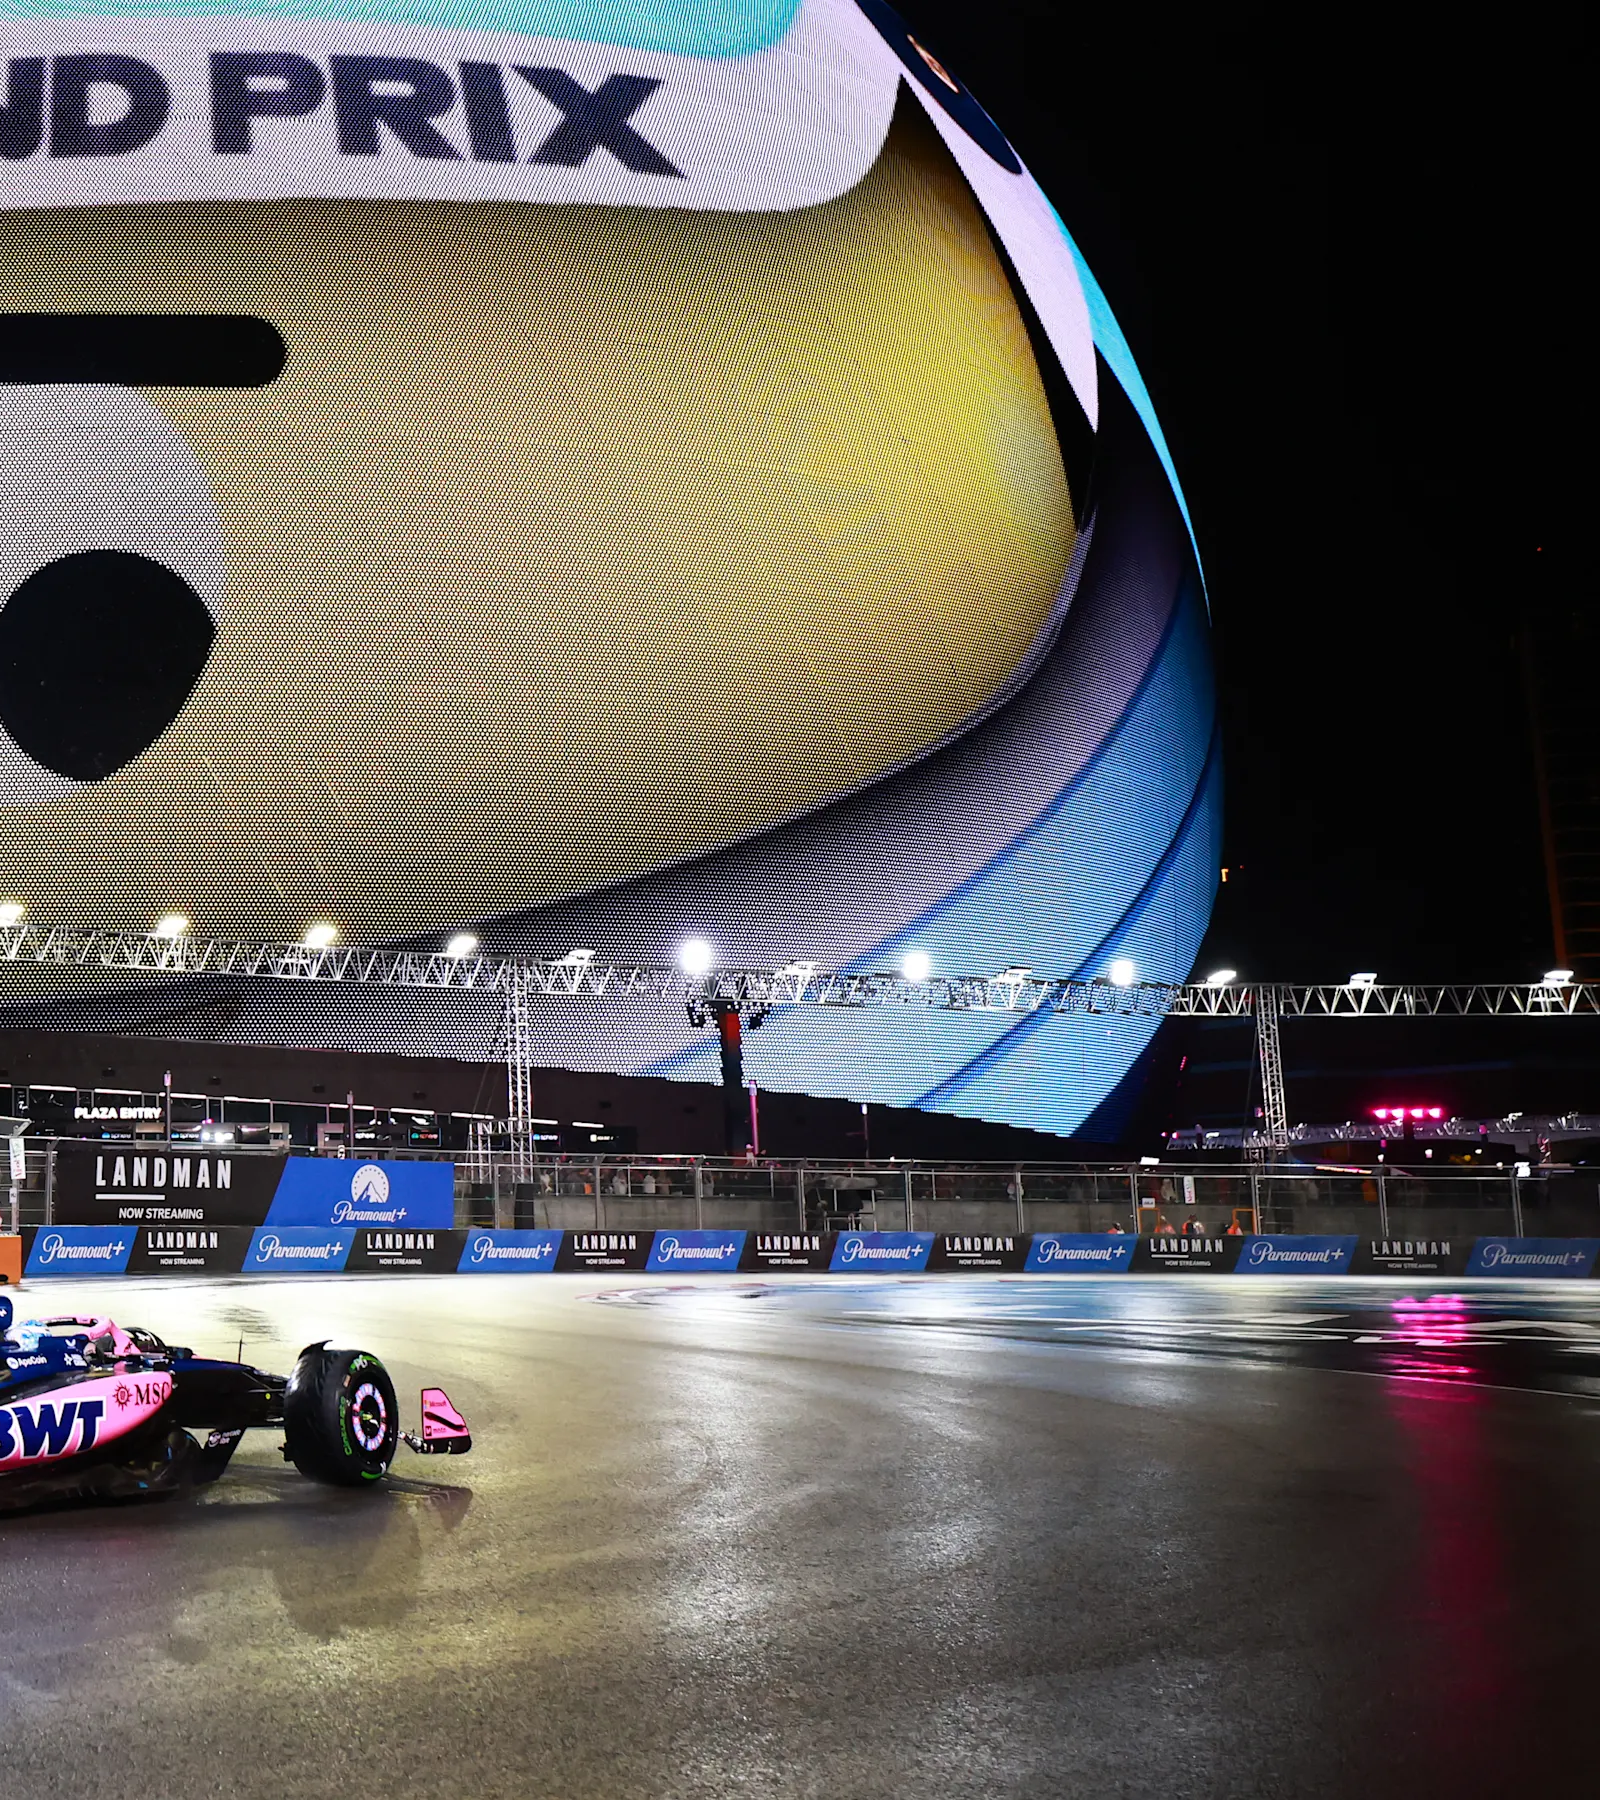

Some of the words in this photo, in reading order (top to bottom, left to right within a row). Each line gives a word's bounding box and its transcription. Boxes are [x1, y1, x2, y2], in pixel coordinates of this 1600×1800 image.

[210, 52, 687, 180] PRIX
[75, 1107, 117, 1119] PLAZA
[120, 1107, 162, 1119] ENTRY
[96, 1156, 231, 1188] LANDMAN
[119, 1208, 144, 1219] NOW
[146, 1208, 204, 1220] STREAMING
[331, 1201, 407, 1224] Paramount+
[40, 1233, 124, 1263] Paramount+
[148, 1232, 217, 1248] LANDMAN
[257, 1234, 343, 1262] Paramount+
[367, 1234, 434, 1249] LANDMAN
[472, 1236, 552, 1262] Paramount+
[574, 1235, 636, 1249] LANDMAN
[659, 1238, 735, 1262] Paramount+
[757, 1236, 820, 1250] LANDMAN
[842, 1238, 923, 1262] Paramount+
[946, 1237, 1014, 1251] LANDMAN
[1038, 1239, 1125, 1263] Paramount+
[1150, 1239, 1223, 1253] LANDMAN
[1372, 1241, 1450, 1256] LANDMAN
[1251, 1241, 1344, 1265] Paramount+
[1482, 1244, 1585, 1268] Paramount+
[134, 1381, 171, 1407] MSC
